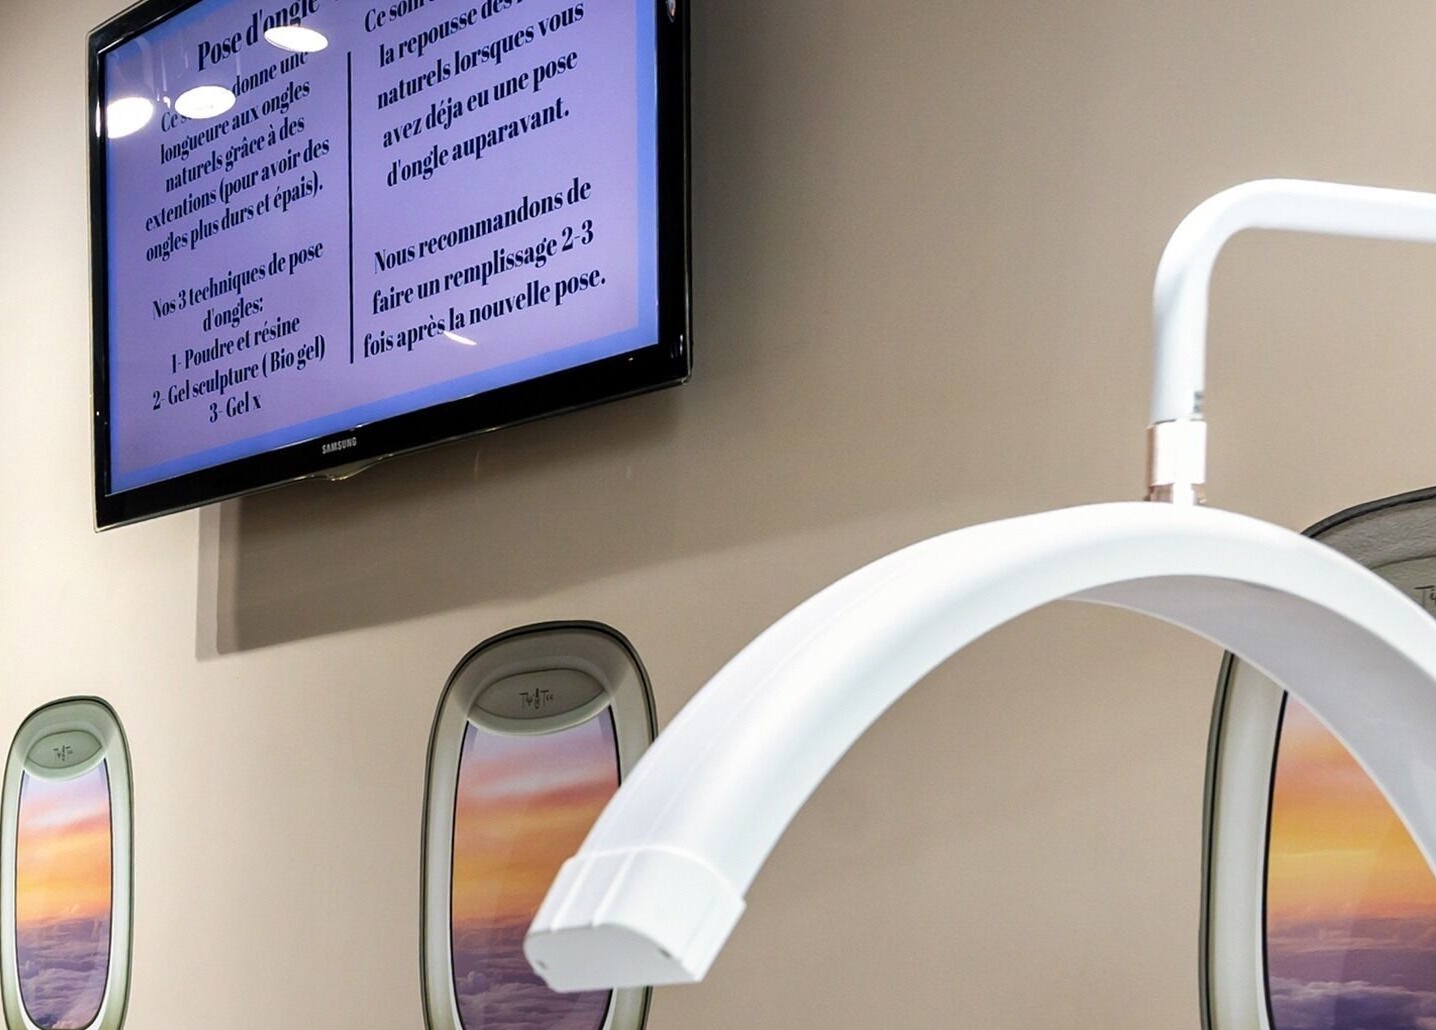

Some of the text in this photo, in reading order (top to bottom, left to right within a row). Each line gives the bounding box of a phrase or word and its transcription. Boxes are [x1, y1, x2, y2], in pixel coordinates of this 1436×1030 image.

[197, 31, 242, 72] Pose
[364, 8, 386, 33] Ce
[377, 3, 585, 110] naturels lorsques vous
[379, 44, 395, 68] la
[398, 8, 478, 58] repousse
[160, 81, 310, 165] longueure aux ongles
[161, 111, 179, 133] Ce
[232, 64, 278, 97] donne
[280, 51, 309, 75] une
[382, 51, 578, 148] avez déja eu une pose
[165, 116, 305, 193] naturels grâce à des
[386, 97, 570, 187] d'ongle auparavant.
[145, 138, 331, 232] extentions (pour avoir des
[146, 170, 324, 262] ongles plus durs et épais).
[374, 176, 592, 274] Nous recommandons de
[153, 242, 324, 320] Nos 3 techniques de pose
[371, 219, 595, 315] faire un remplissage 2-3
[184, 338, 235, 370] Poudre
[237, 330, 251, 351] et
[254, 316, 301, 347] résine
[203, 297, 264, 332] d'ongles:
[363, 268, 607, 359] fois après la nouvelle pose.
[168, 379, 191, 406] Gel
[192, 362, 259, 399] sculpture
[296, 334, 326, 371] gel)
[226, 391, 250, 418] Gel
[321, 436, 357, 455] SAMSUNG
